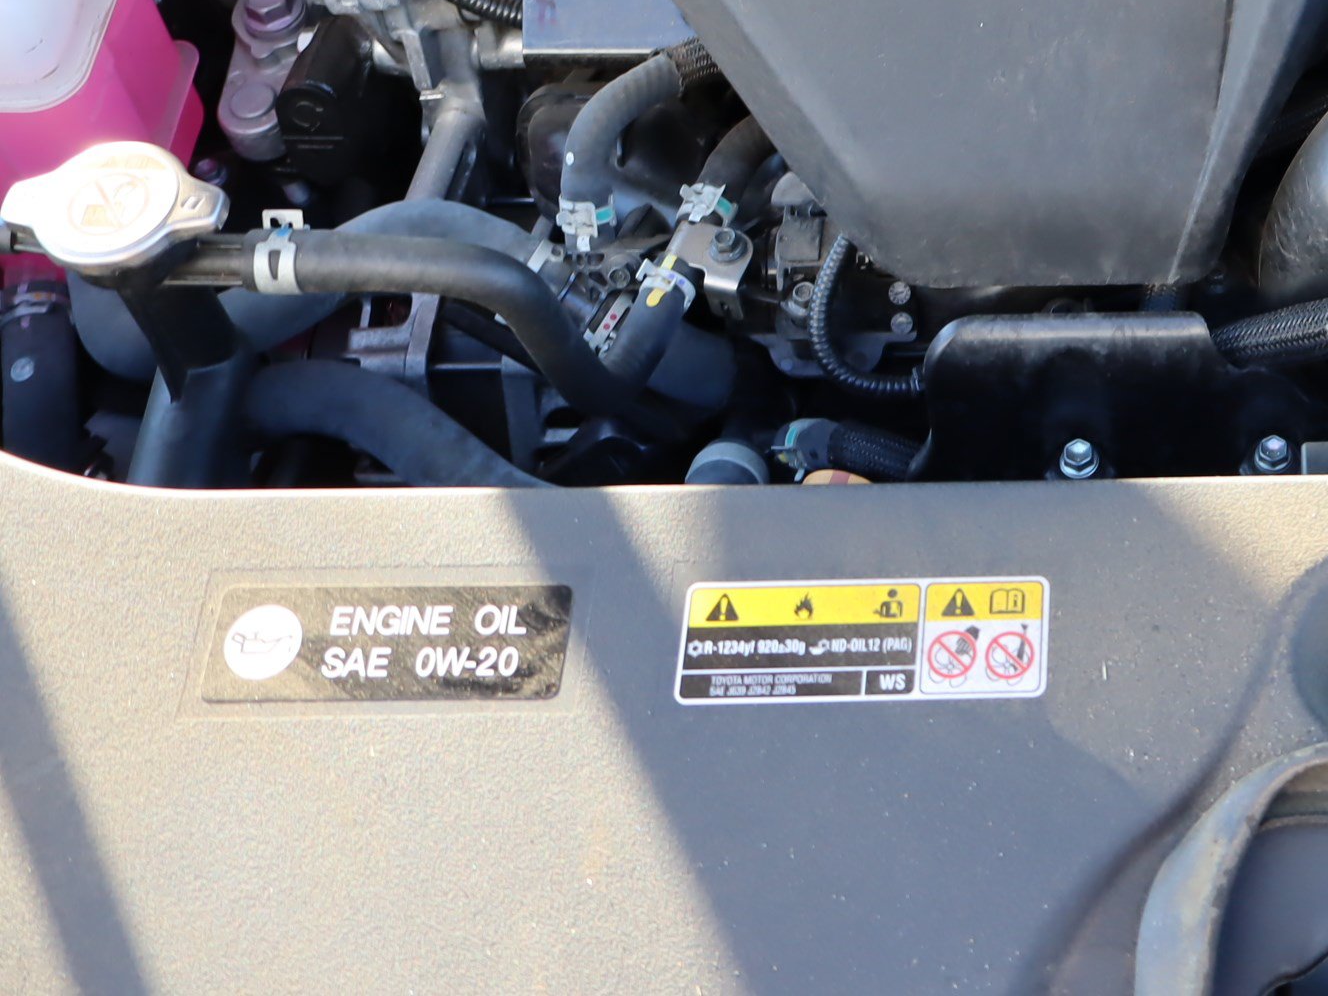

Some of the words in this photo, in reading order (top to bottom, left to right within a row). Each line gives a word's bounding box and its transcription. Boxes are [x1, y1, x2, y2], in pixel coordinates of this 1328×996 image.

[329, 605, 454, 636] ENGINE
[473, 604, 528, 635] OIL
[703, 639, 756, 657] R-1234yf
[882, 636, 913, 654] (PAG)
[321, 647, 393, 679] SAE
[415, 646, 520, 678] 0W-20
[711, 675, 743, 685] TOYOTA
[743, 674, 774, 685] MOTOR
[774, 673, 833, 684] CORPORATION
[879, 673, 907, 691] WS
